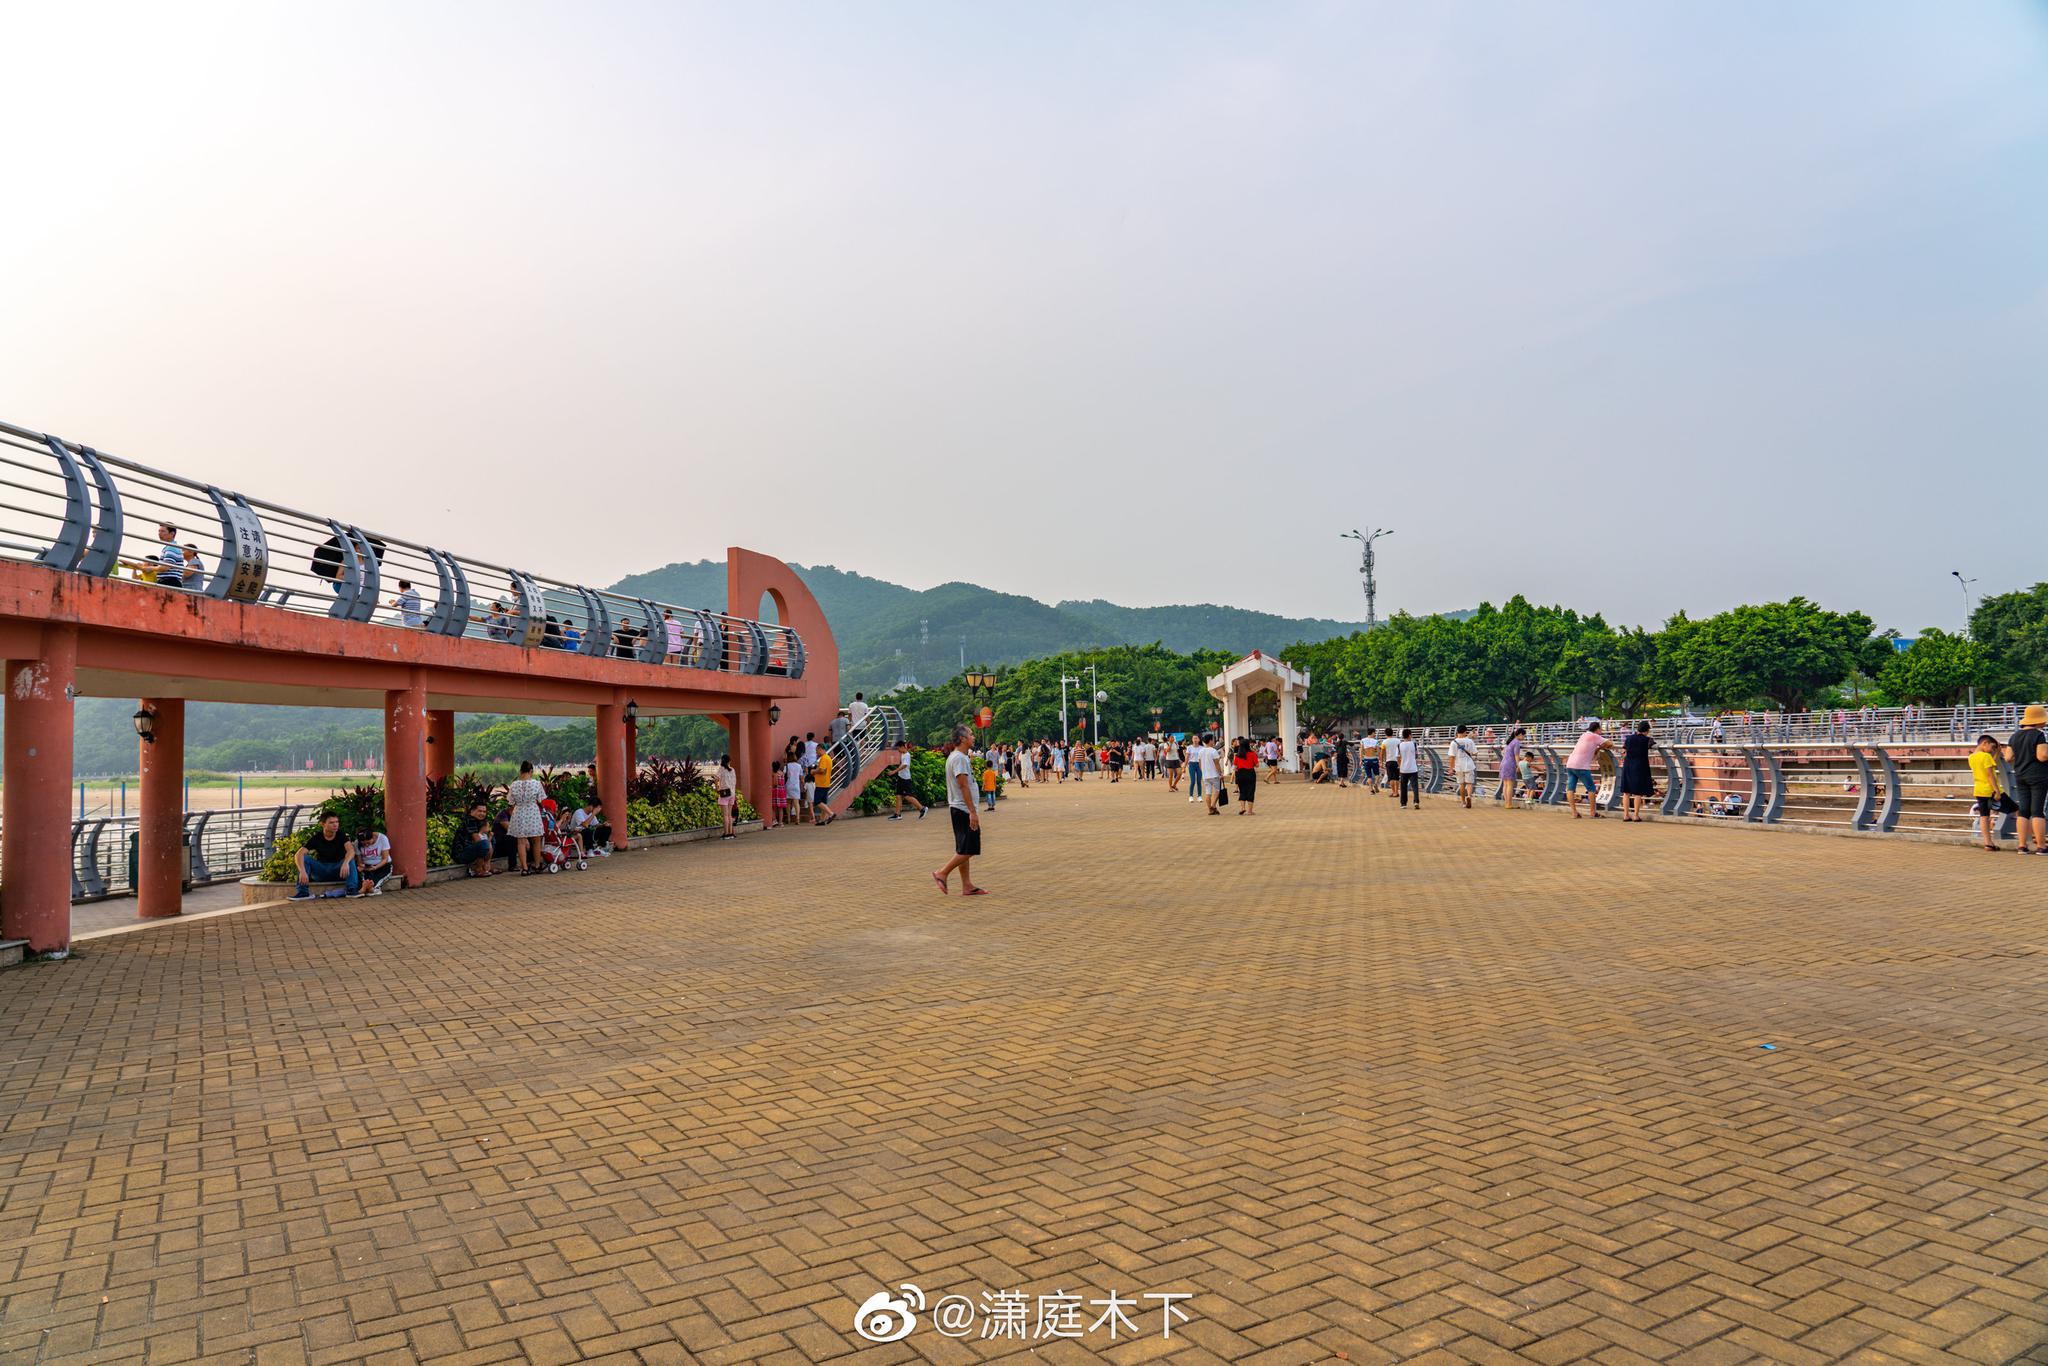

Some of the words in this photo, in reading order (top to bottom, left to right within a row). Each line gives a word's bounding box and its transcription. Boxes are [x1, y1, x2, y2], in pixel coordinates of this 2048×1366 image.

[235, 526, 252, 593] 注意安全
[247, 529, 263, 595] 请勿攀爬
